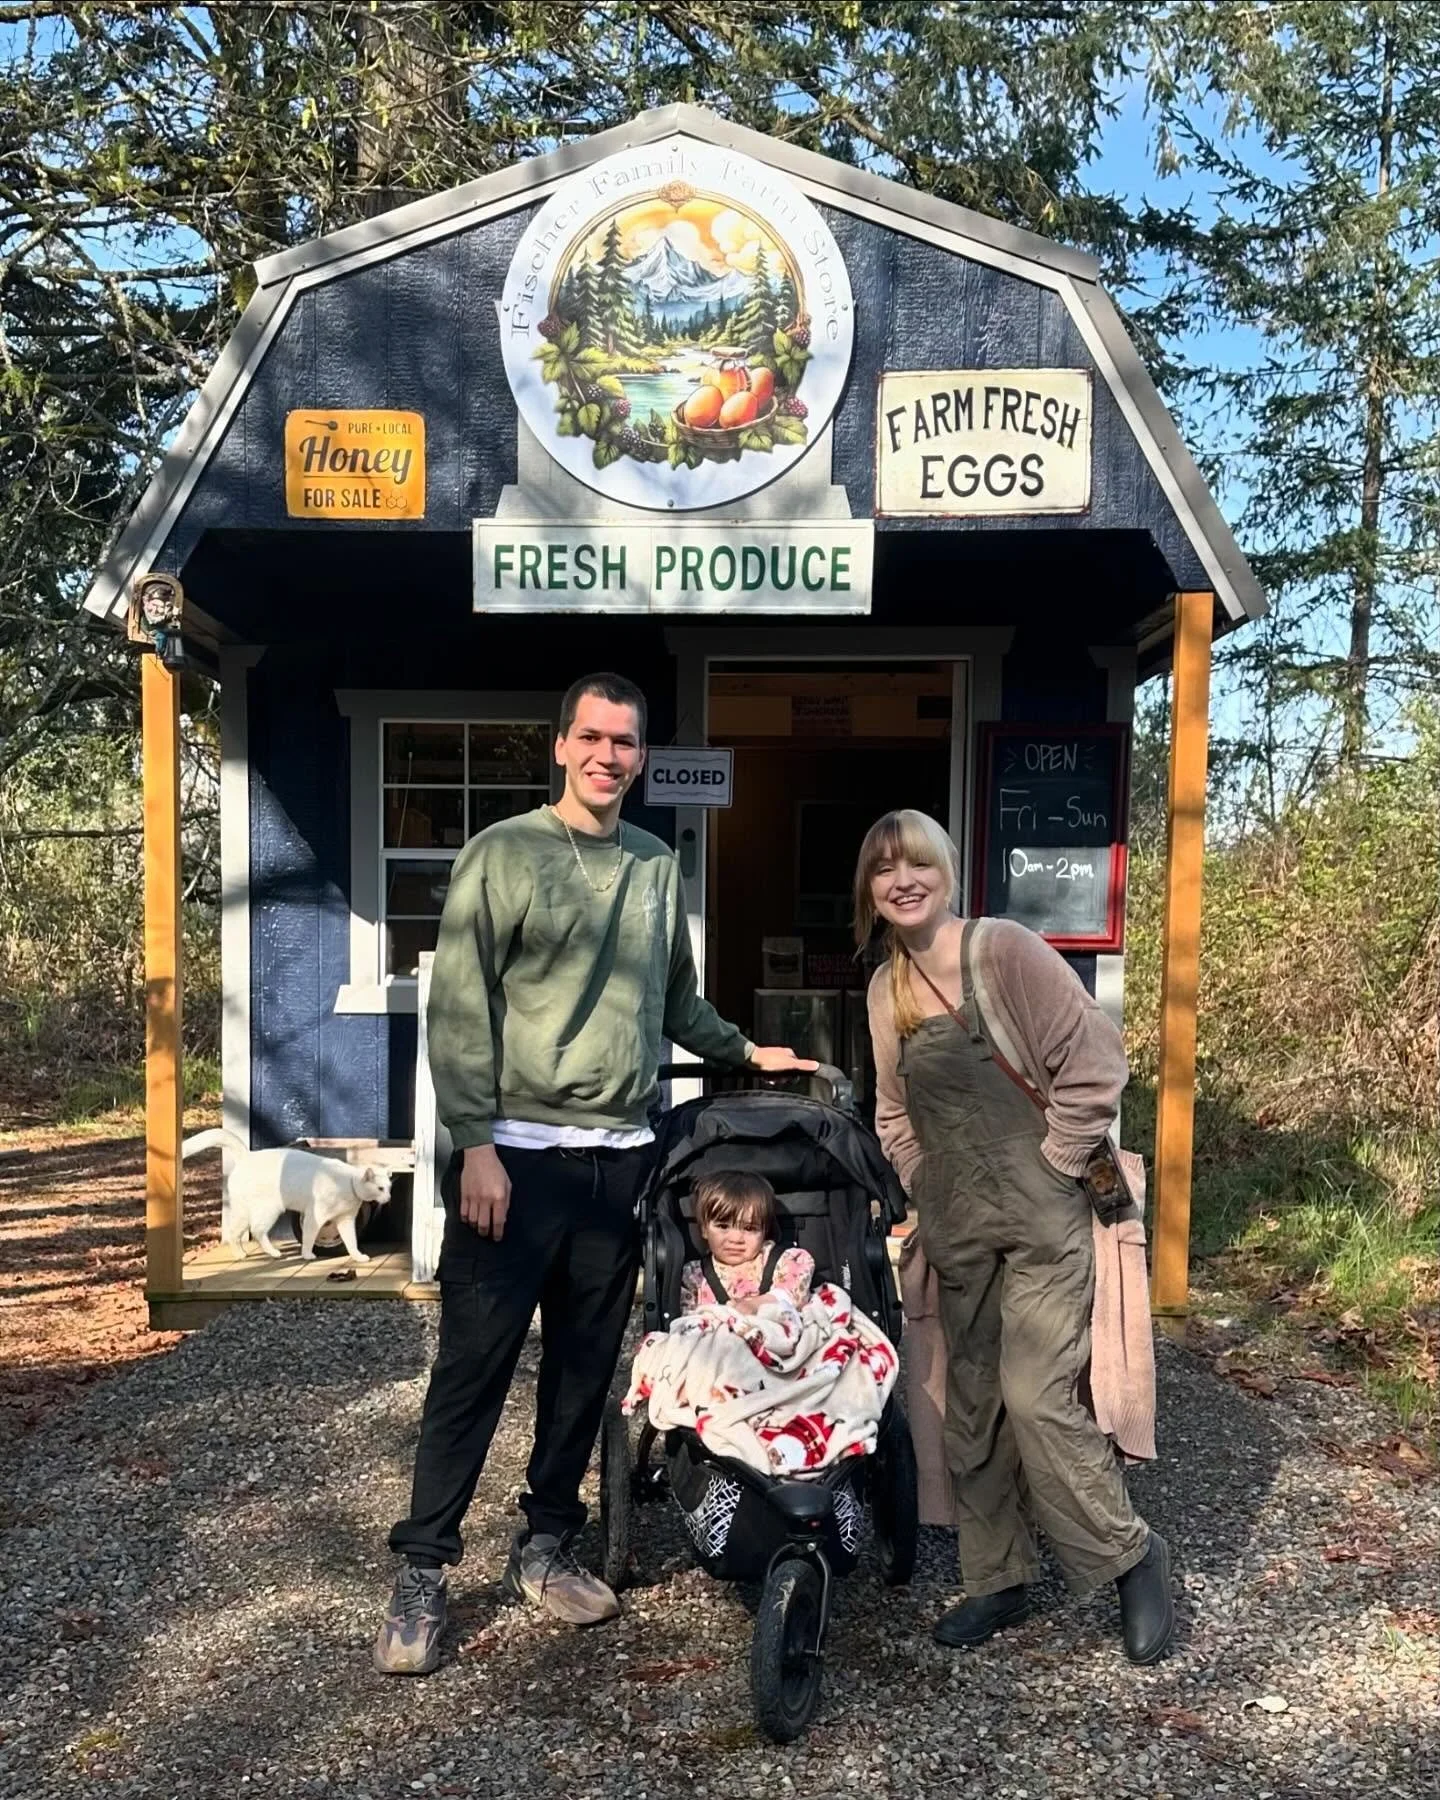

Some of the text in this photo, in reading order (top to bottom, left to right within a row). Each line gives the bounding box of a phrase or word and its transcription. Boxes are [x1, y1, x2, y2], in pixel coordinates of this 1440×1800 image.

[511, 152, 839, 341] Fischer Family Farm Store
[348, 423, 413, 434] PURE LOCAL
[886, 386, 1081, 453] FARM FRESH
[299, 436, 412, 485] Honey
[920, 453, 1044, 498] EGGS
[304, 488, 381, 508] FOR SALE
[494, 544, 851, 592] FRESH PRODUCE
[652, 768, 725, 785] CLOSED
[1025, 743, 1078, 772] OPEN
[1000, 788, 1036, 830] Fri
[1067, 796, 1107, 828] Sun
